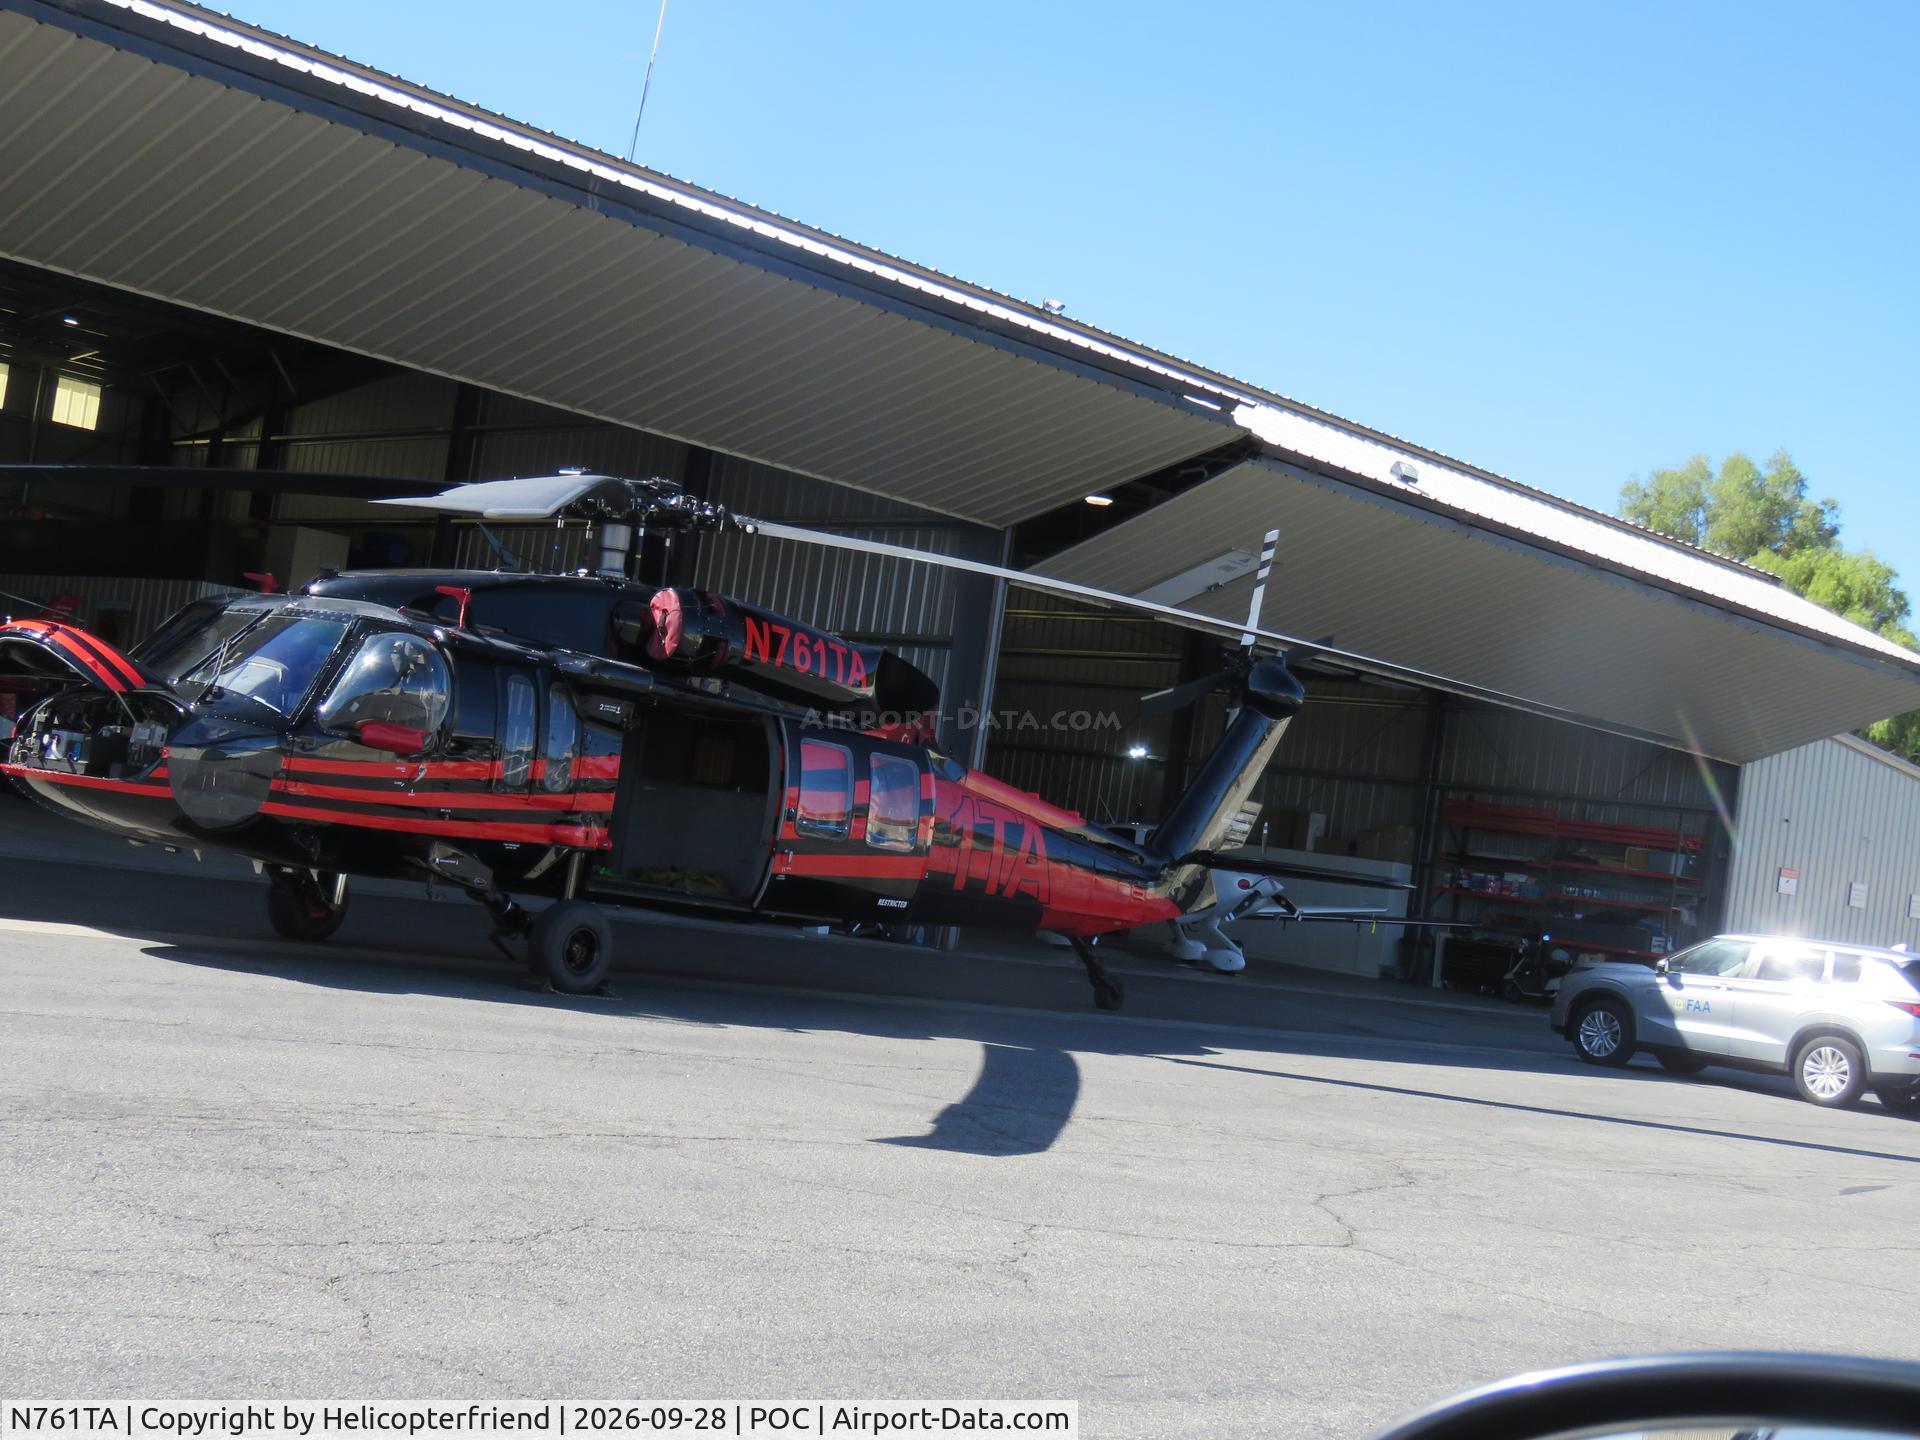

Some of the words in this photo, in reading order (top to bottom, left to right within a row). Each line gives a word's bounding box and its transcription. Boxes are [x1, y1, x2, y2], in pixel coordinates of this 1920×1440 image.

[743, 616, 868, 689] N761TA
[877, 898, 908, 909] RESTRICTED
[1686, 999, 1712, 1013] FAA
